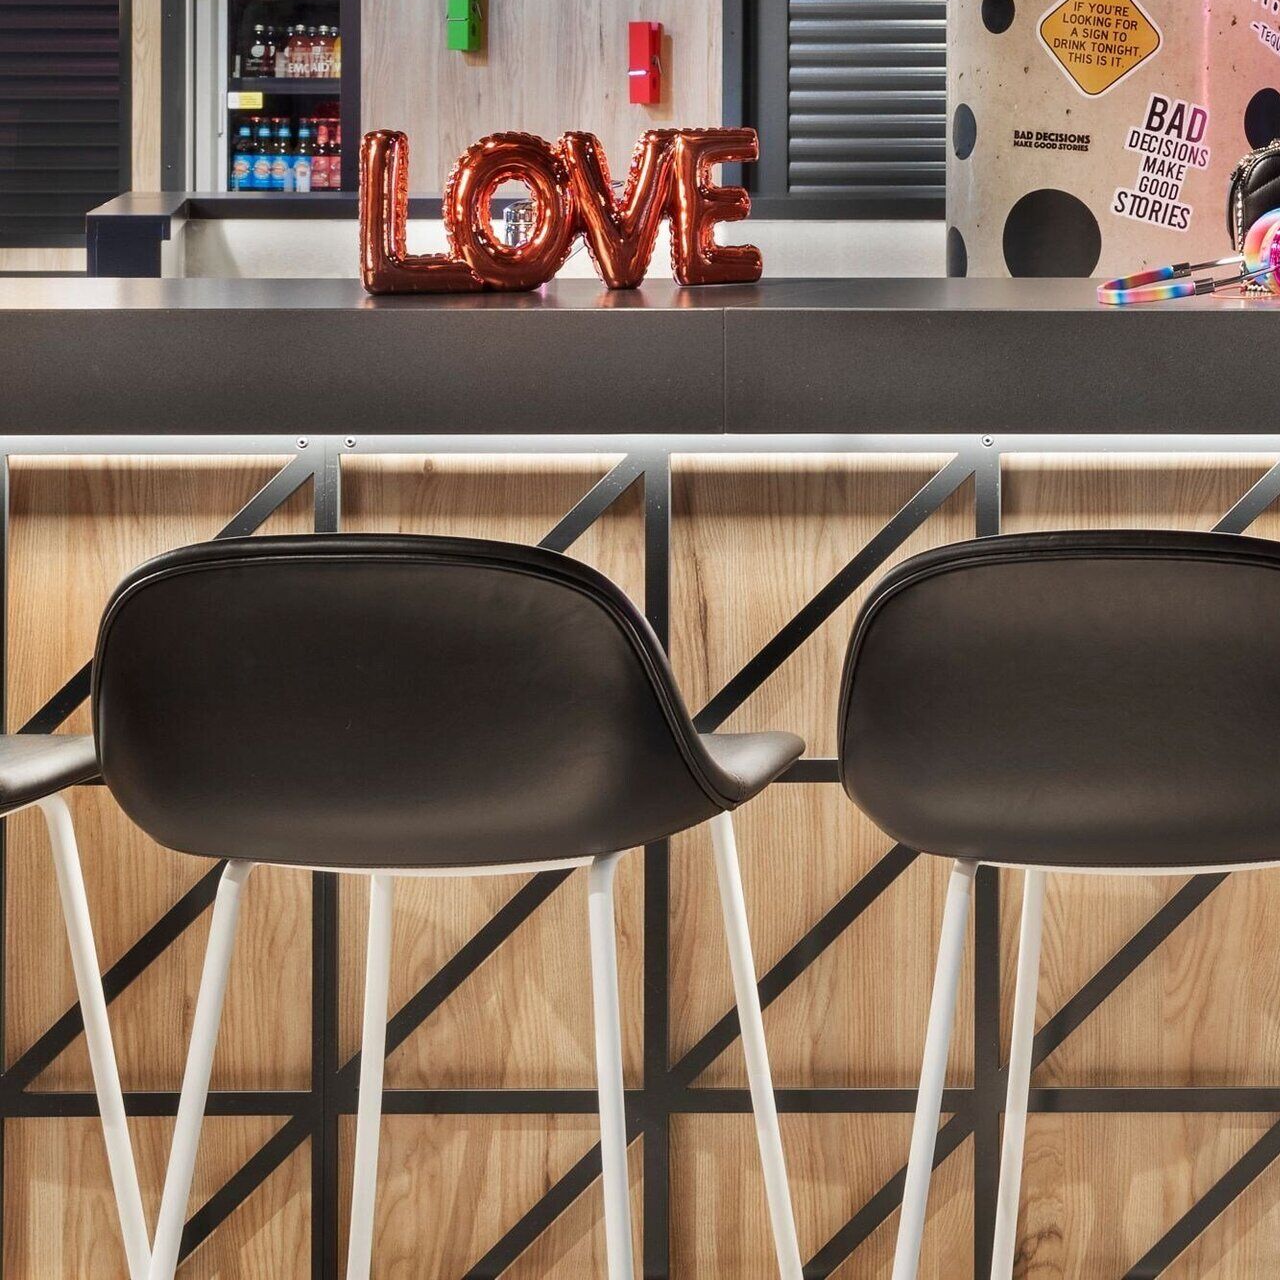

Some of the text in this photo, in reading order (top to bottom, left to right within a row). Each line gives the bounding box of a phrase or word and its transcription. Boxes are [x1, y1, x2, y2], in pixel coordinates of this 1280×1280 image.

[1073, 1, 1129, 17] IF YOU'RE
[1063, 13, 1138, 30] LOOKING FOR
[1070, 27, 1127, 42] A SIGN TO
[1053, 38, 1142, 58] DRINK TONIGHT.
[1068, 52, 1124, 68] THIS IS IT.
[1145, 96, 1207, 143] BAD
[1013, 140, 1089, 152] MAKE GOOD STORIES
[1014, 130, 1091, 144] BAD DECISIONS
[1129, 130, 1208, 167] DECISIONS
[1143, 156, 1186, 181] MAKE
[1139, 176, 1179, 200] GOOD
[359, 127, 762, 294] LOVE
[1114, 191, 1190, 229] STORIES
